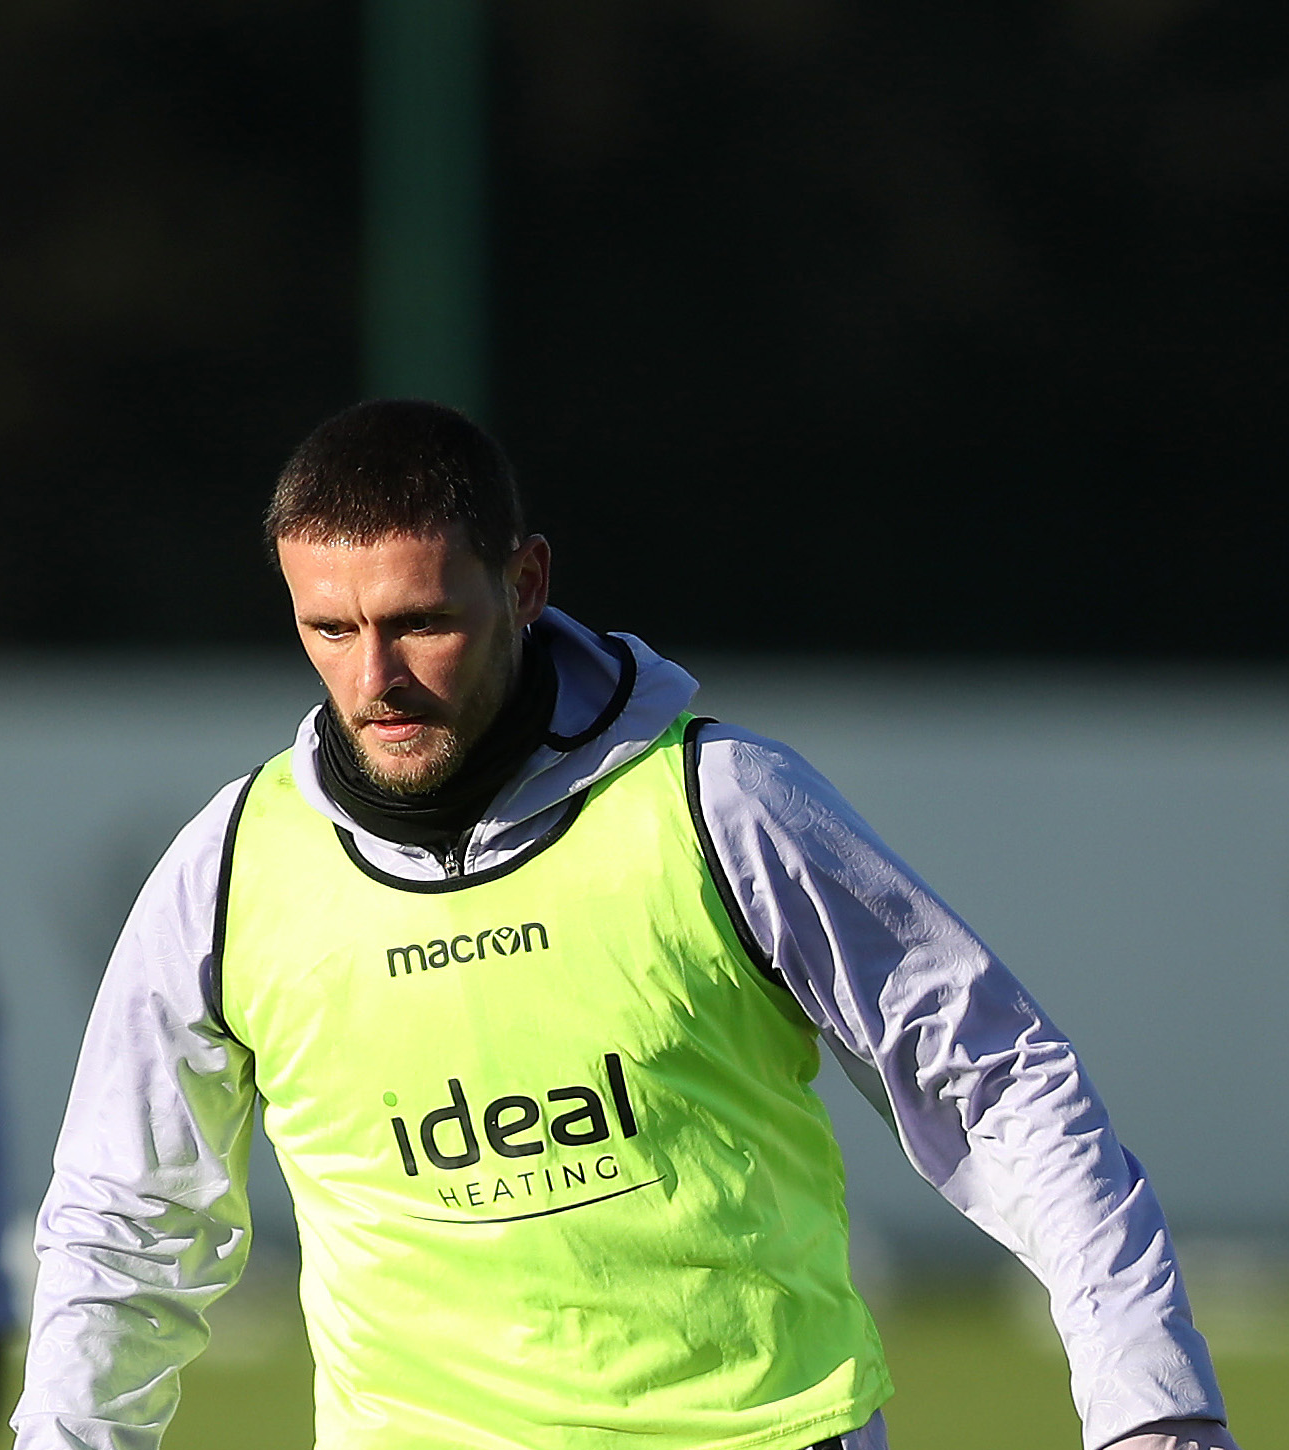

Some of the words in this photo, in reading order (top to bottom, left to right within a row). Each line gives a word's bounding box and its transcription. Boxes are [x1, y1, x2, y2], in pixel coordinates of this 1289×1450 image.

[385, 921, 550, 978] macron
[382, 1052, 639, 1178] ideal
[437, 1154, 621, 1209] HEATING
